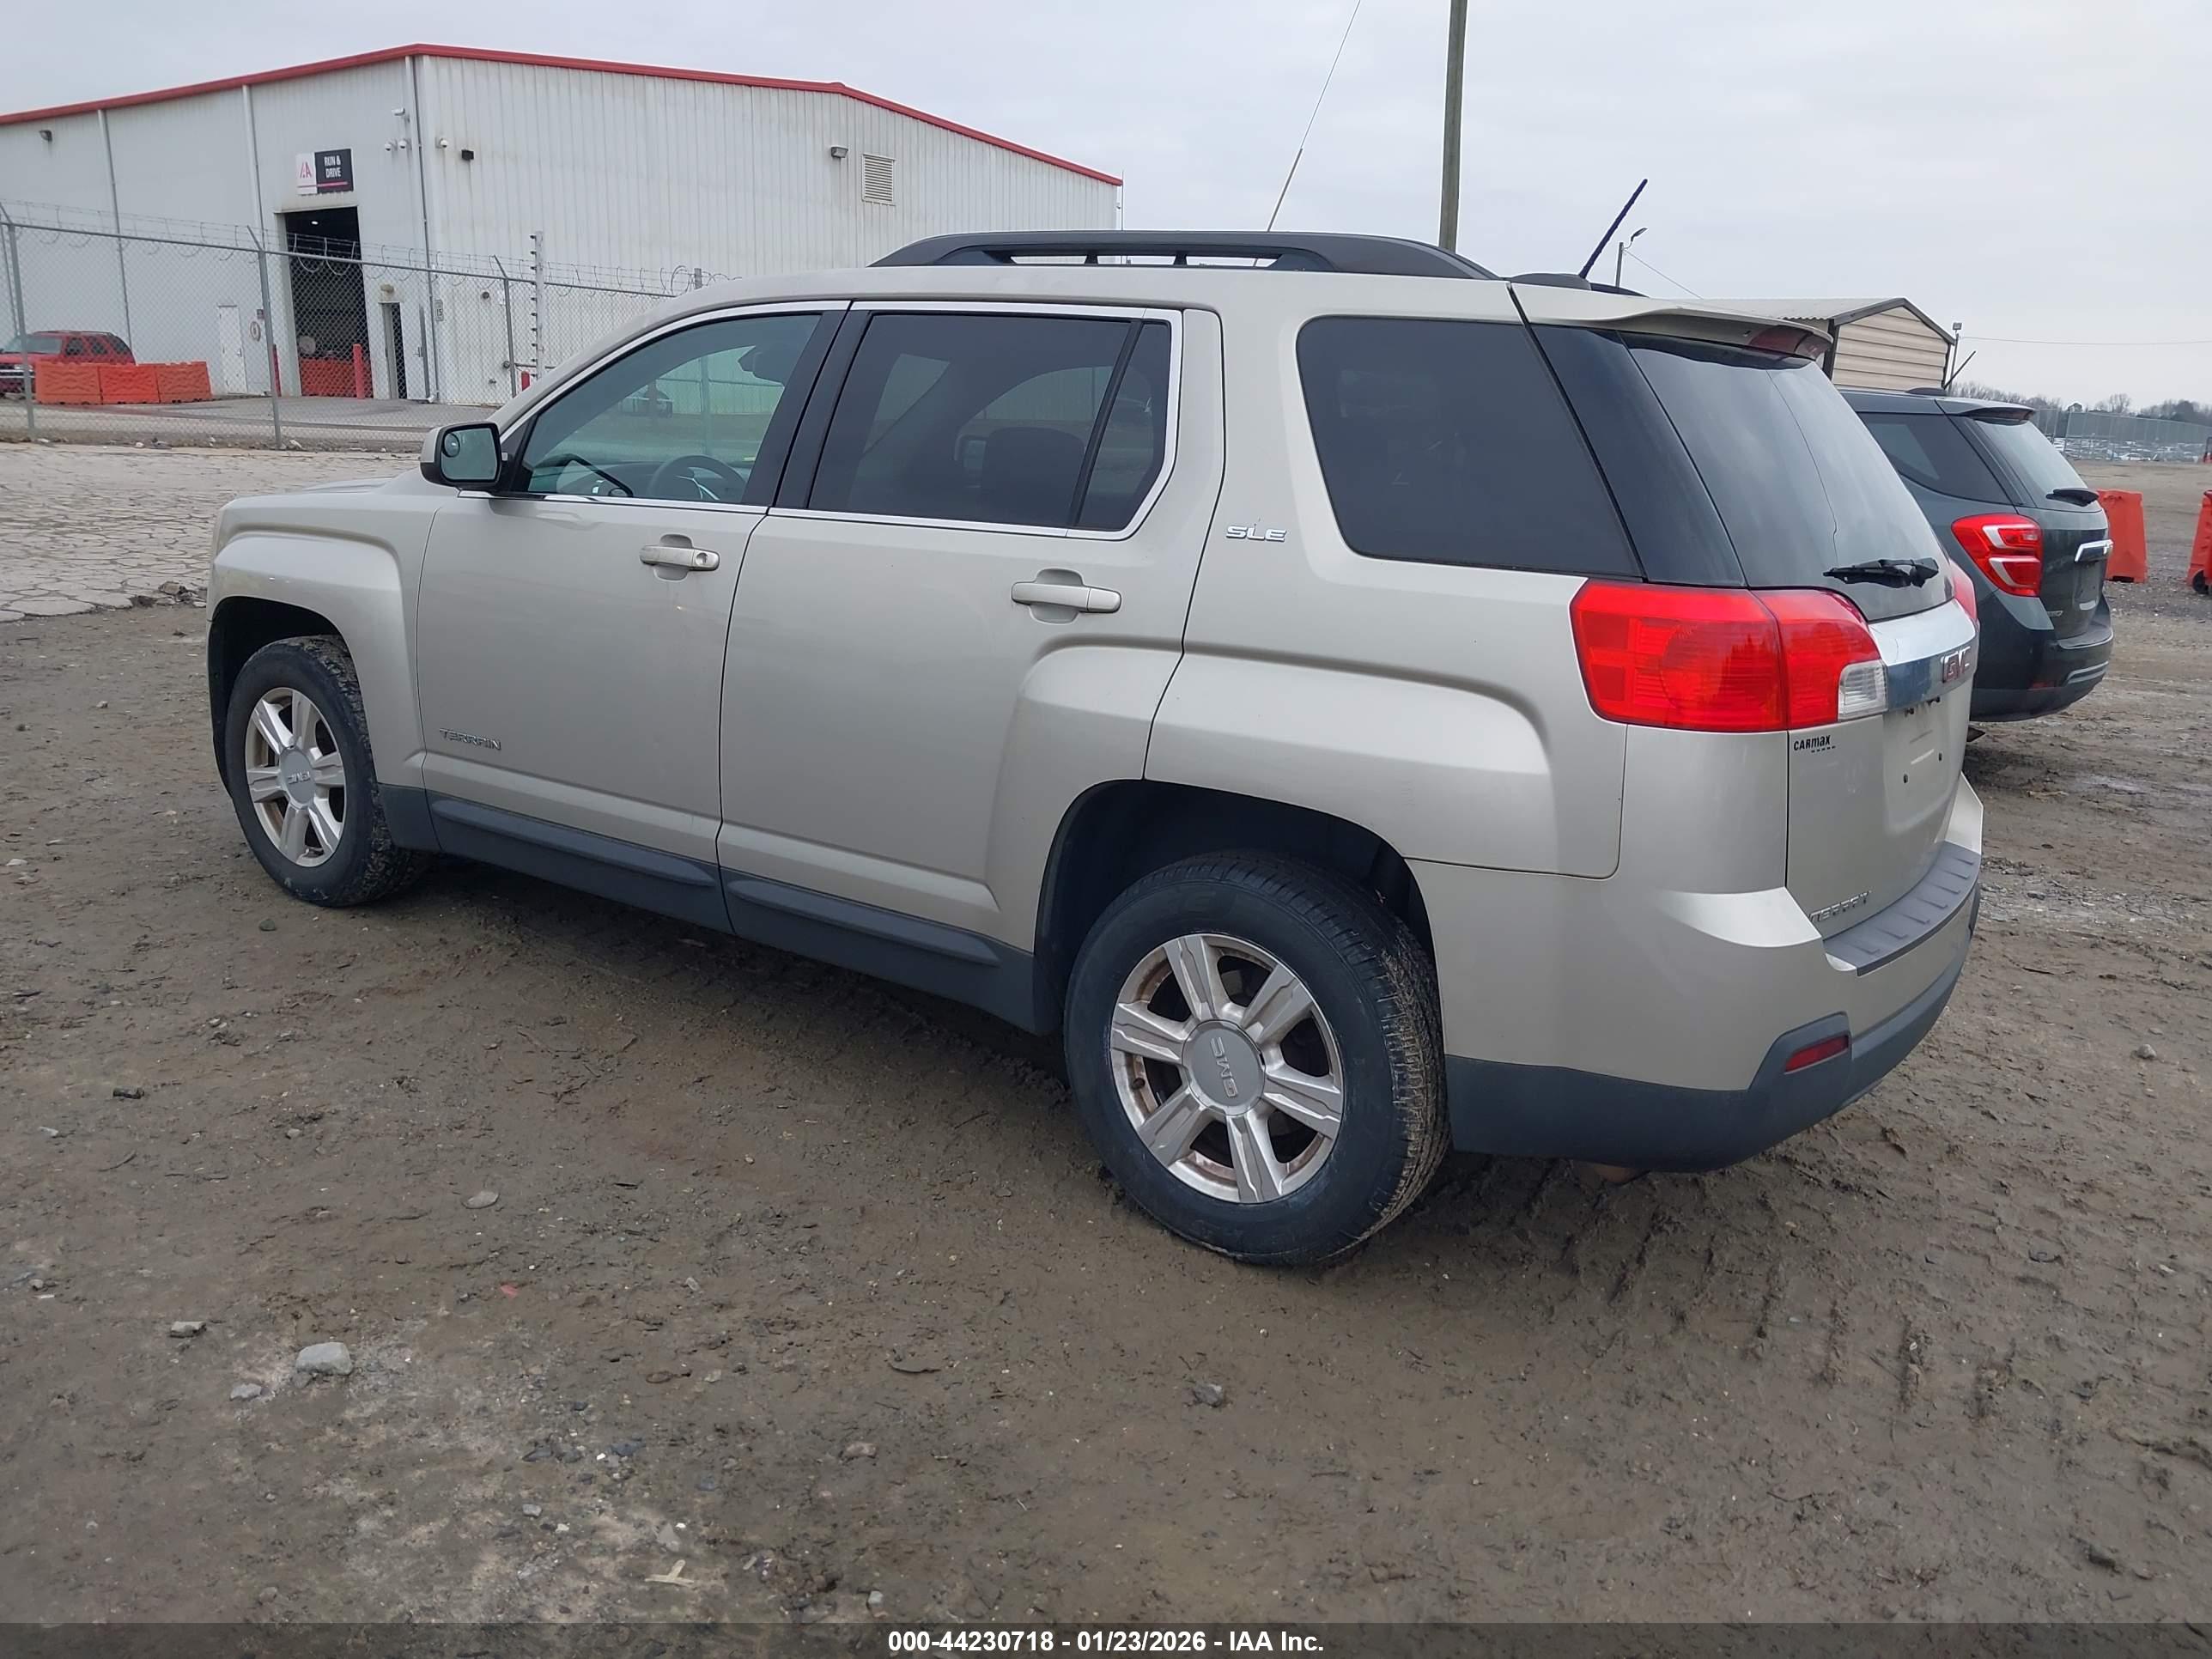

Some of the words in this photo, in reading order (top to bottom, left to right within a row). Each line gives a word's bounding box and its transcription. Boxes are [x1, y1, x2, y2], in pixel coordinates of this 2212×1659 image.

[324, 156, 336, 167] RUN
[336, 155, 342, 165] &
[325, 167, 342, 179] DRIVE
[1226, 526, 1286, 542] SLE
[440, 728, 501, 750] TERRAIN
[1210, 1036, 1238, 1098] GMC
